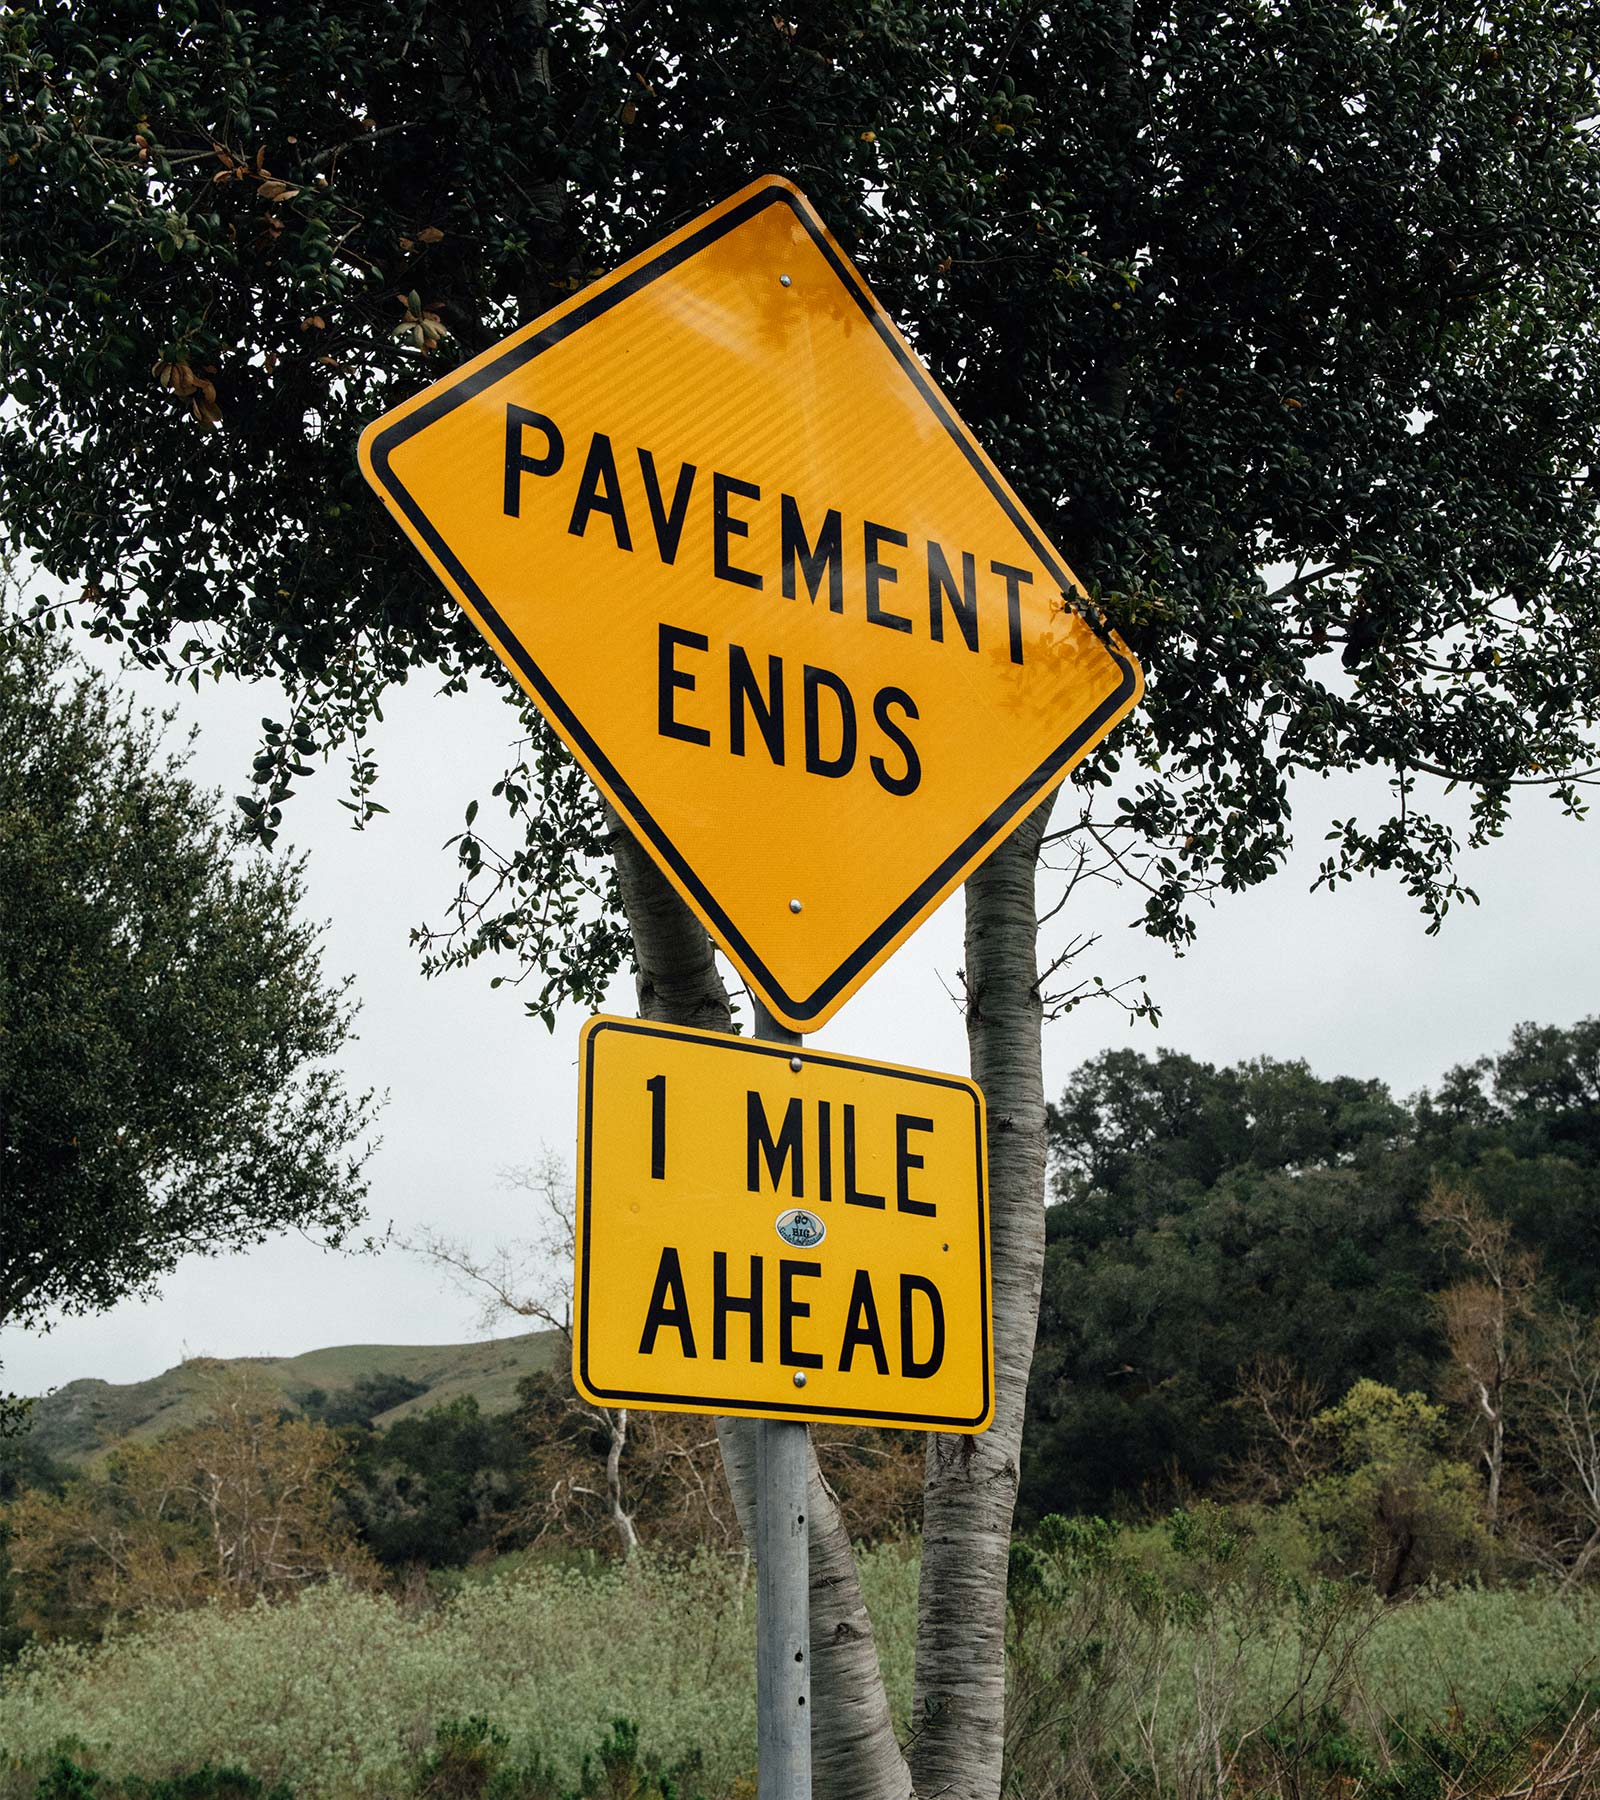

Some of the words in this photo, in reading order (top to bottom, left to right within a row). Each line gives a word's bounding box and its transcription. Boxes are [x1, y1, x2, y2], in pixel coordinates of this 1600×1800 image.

[503, 402, 1034, 666] PAVEMENT
[658, 622, 922, 797] ENDS
[646, 1074, 667, 1180] 1
[746, 1090, 937, 1218] MILE
[791, 1227, 811, 1239] BIG
[794, 1214, 809, 1225] GO
[638, 1246, 946, 1379] AHEAD
